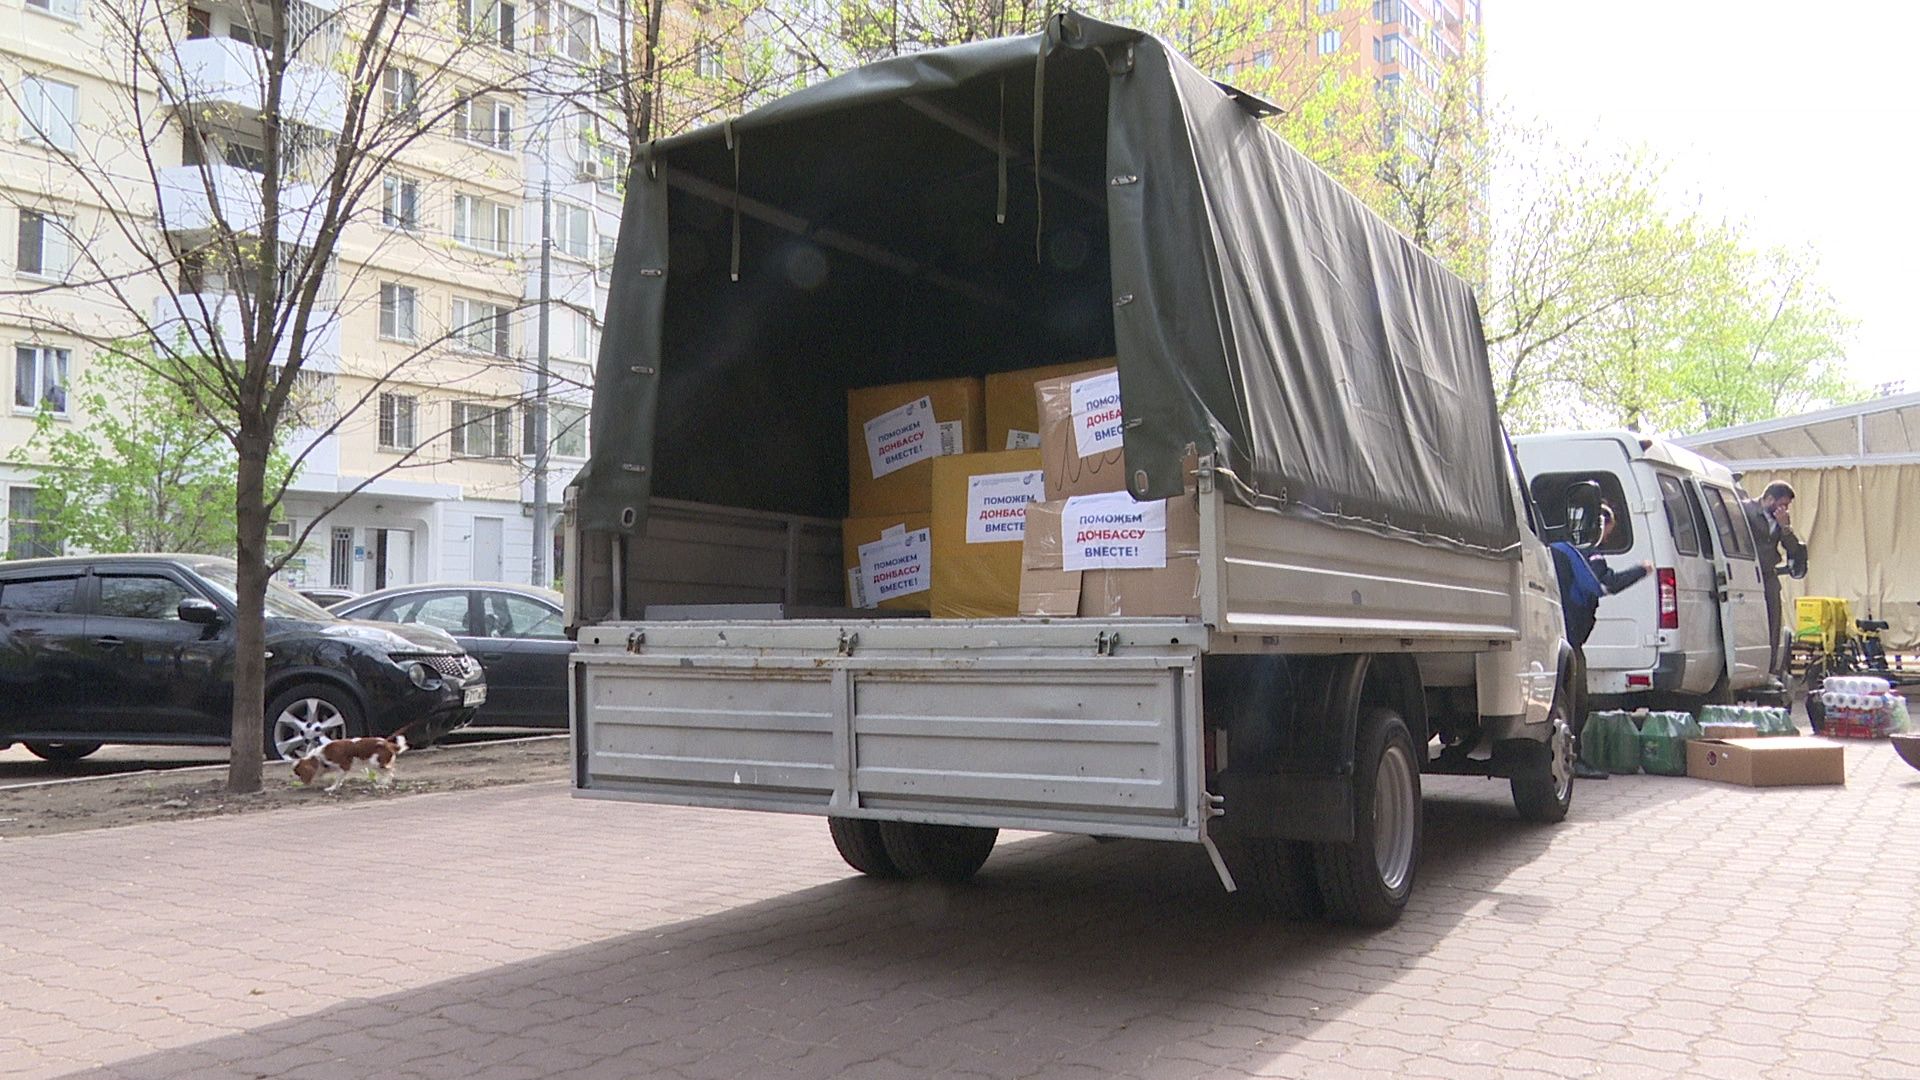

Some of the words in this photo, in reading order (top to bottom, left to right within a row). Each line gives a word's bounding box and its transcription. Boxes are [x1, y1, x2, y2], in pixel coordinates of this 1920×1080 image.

[1086, 394, 1121, 411] ПОМО
[1087, 408, 1124, 428] ДОНБА
[878, 421, 920, 442] ПОМОЖЕМ
[1094, 423, 1124, 441] ВМЕС
[879, 431, 924, 456] ДОНБАССУ
[885, 445, 922, 464] ВМЕСТЕ!
[983, 494, 1036, 505] ПОМОЖЕМ
[979, 508, 1026, 520] ДОНБАС
[1079, 514, 1142, 524] ПОМОЖЕМ
[985, 521, 1025, 532] ВМЕСТЕ
[1076, 530, 1145, 543] ДОНБАССУ
[874, 554, 917, 570] ПОМОЖЕМ
[873, 565, 920, 584] ДОНБАССУ
[880, 577, 918, 593] ВМЕСТЕ!
